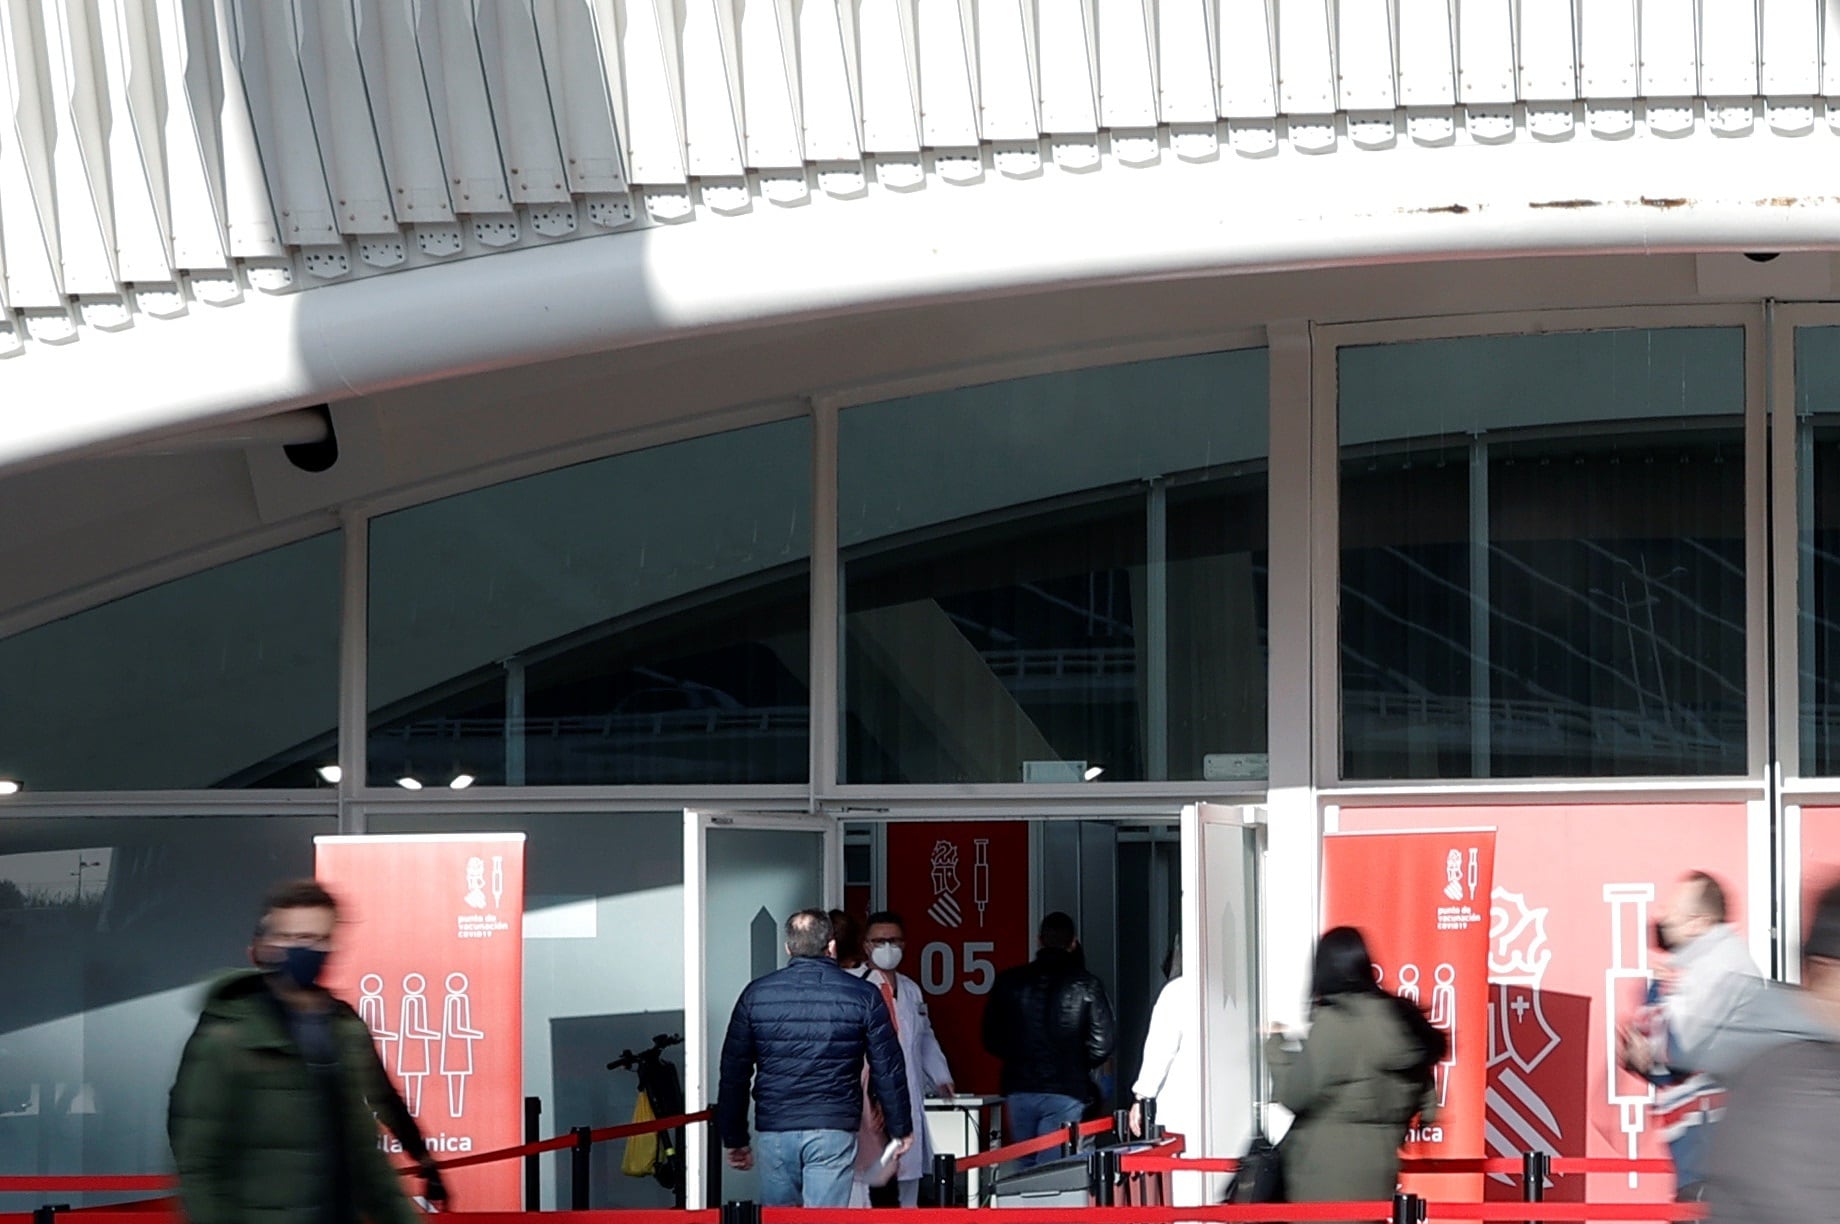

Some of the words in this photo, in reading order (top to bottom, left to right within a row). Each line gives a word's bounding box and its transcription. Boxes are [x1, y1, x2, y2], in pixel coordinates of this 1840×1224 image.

[920, 941, 996, 996] 05
[376, 1134, 404, 1153] ila
[424, 1132, 472, 1153] nica
[1404, 1124, 1444, 1143] nica
